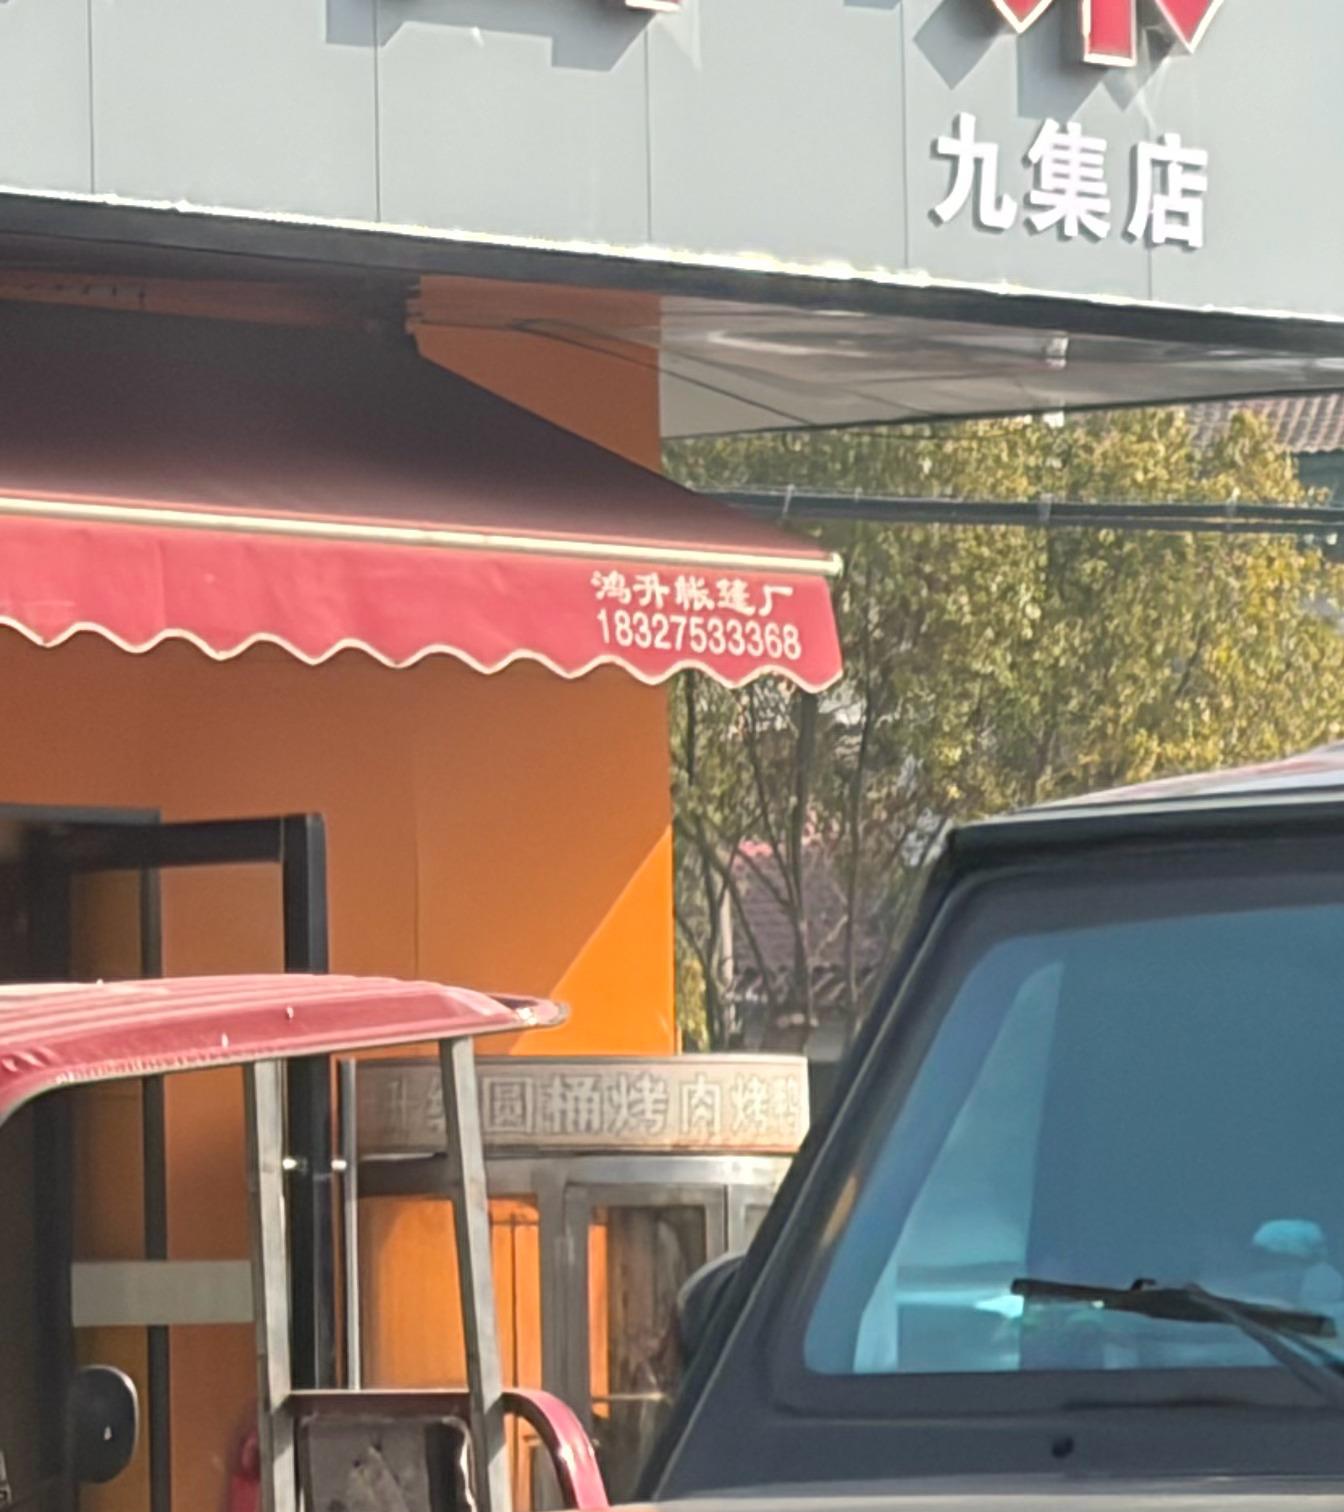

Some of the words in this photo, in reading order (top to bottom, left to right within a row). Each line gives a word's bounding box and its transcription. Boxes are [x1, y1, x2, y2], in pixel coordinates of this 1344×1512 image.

[934, 111, 1208, 249] 九集店
[597, 608, 802, 660] 18327533368
